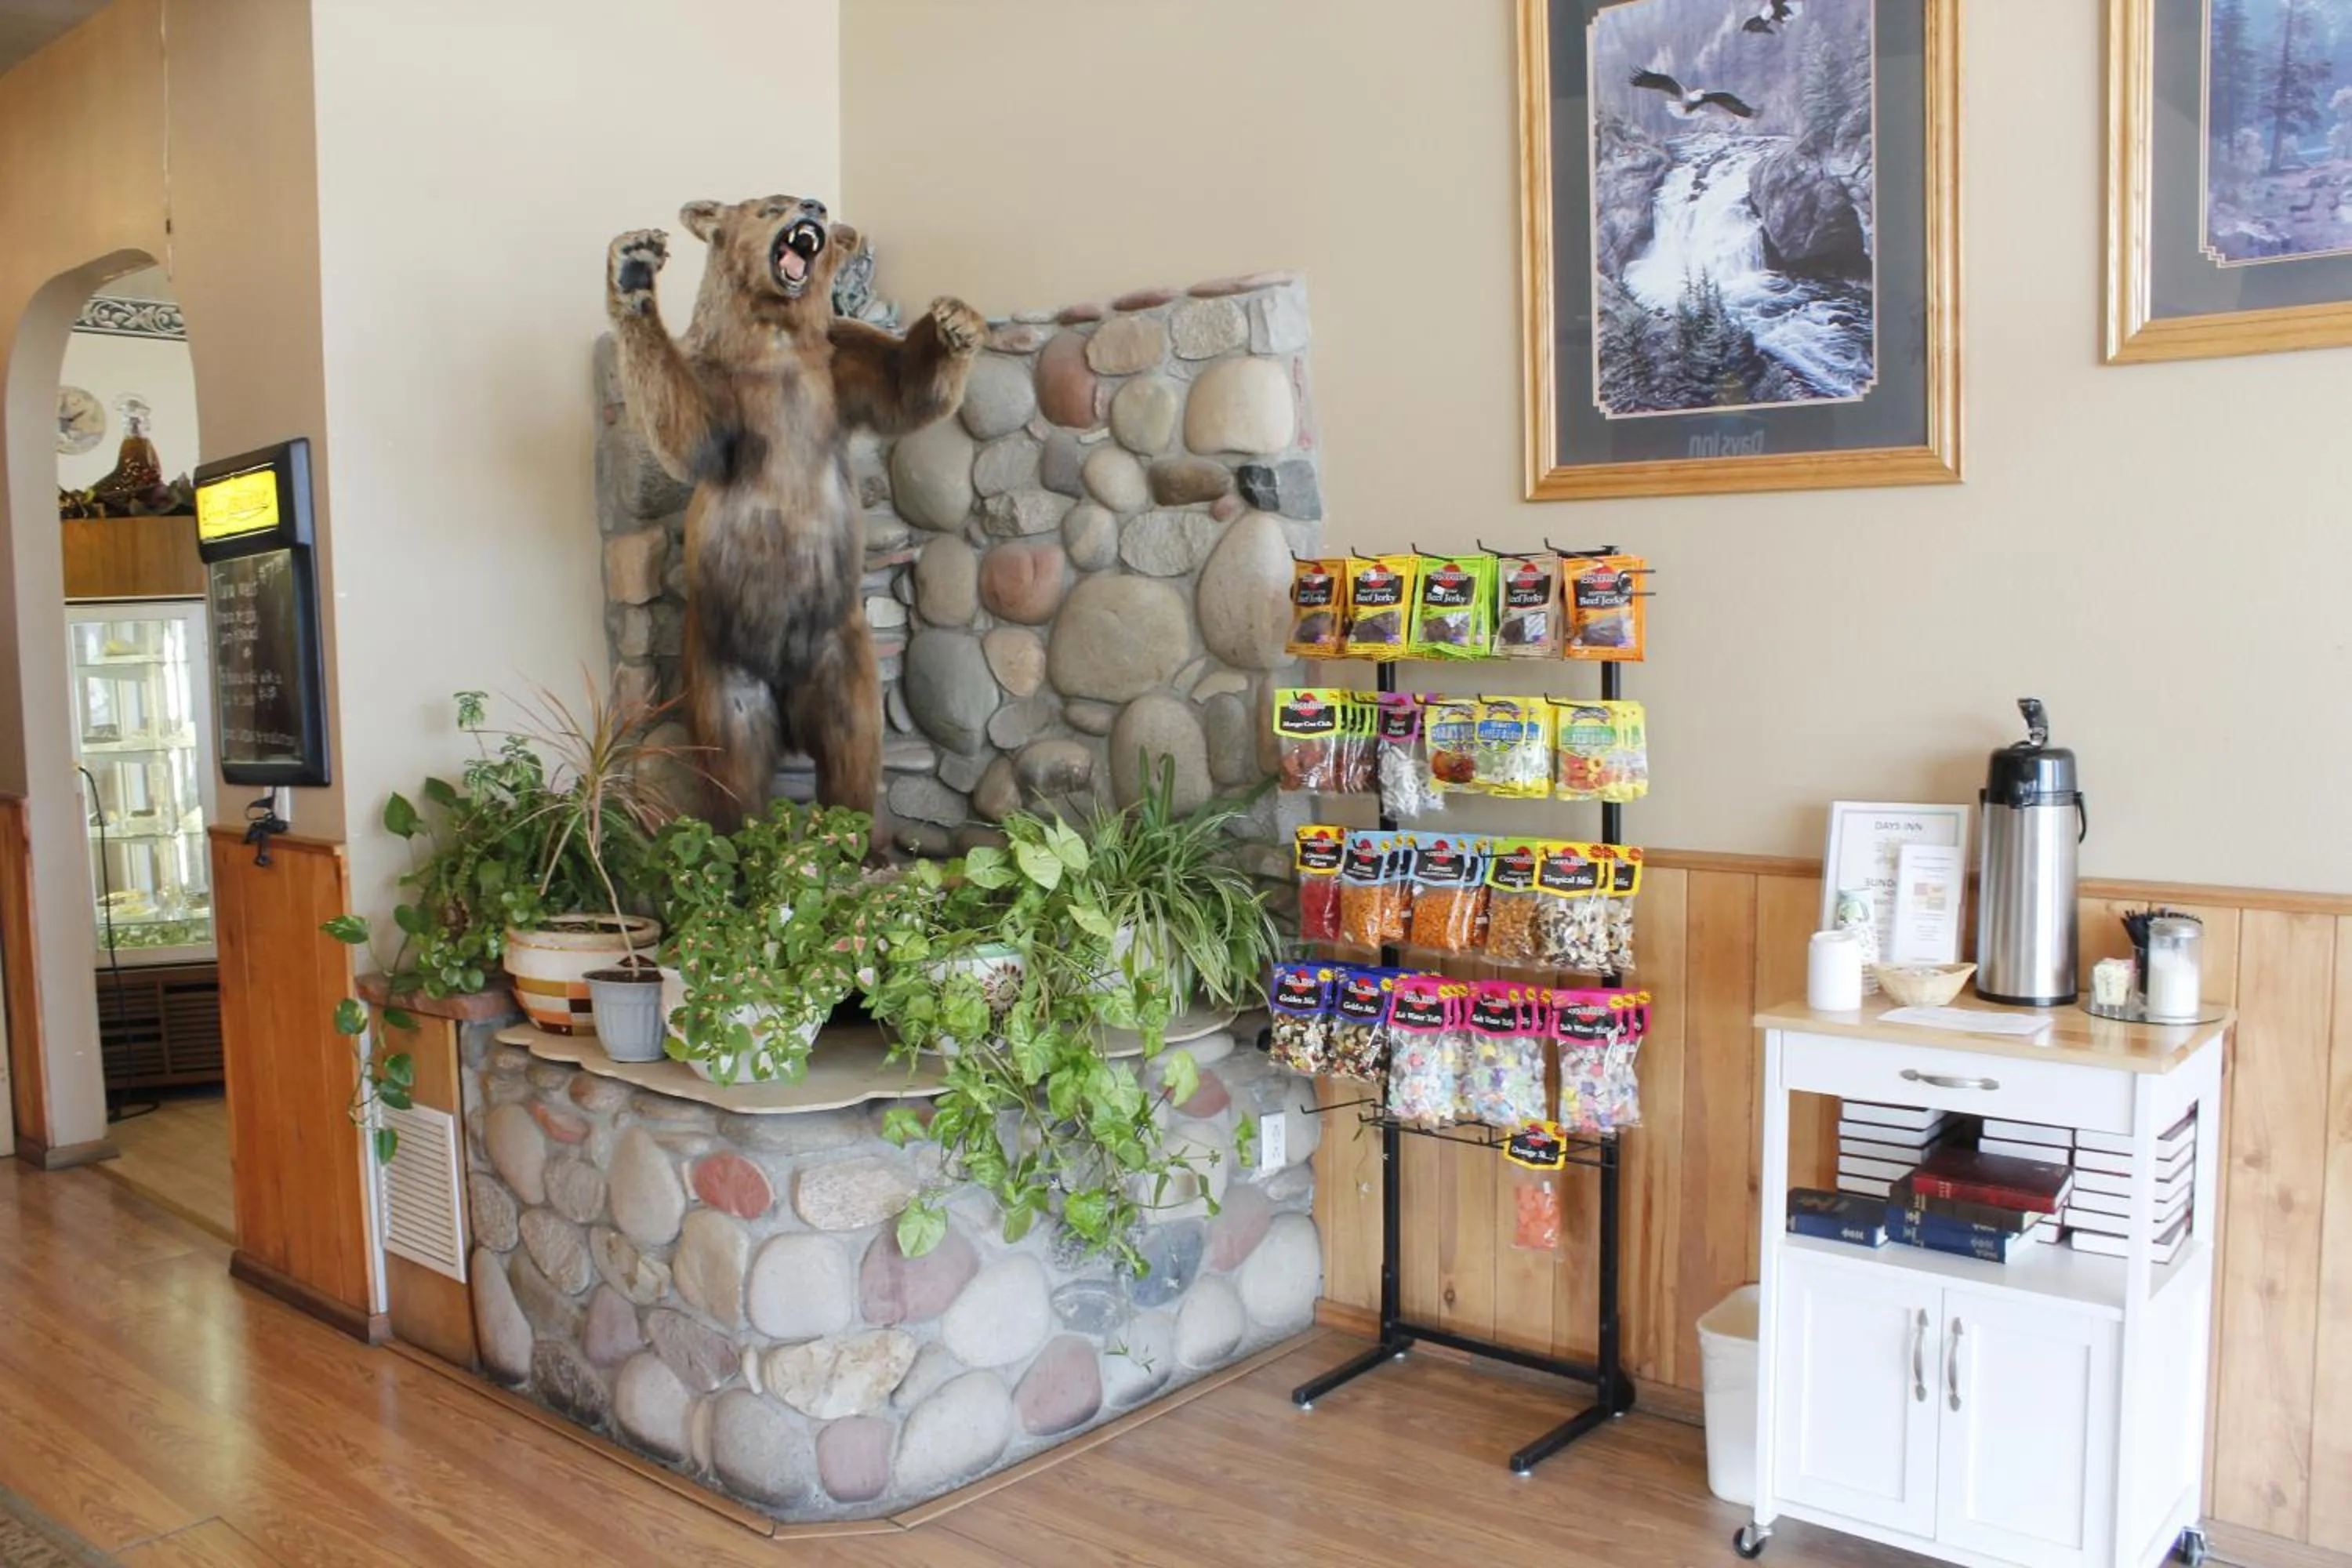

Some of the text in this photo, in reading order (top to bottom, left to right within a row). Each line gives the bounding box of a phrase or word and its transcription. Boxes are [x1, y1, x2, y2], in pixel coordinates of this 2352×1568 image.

[1356, 593, 1396, 604] Beef Jerky
[1444, 593, 1468, 604] Jerky
[1579, 596, 1630, 606] Beef Jerky
[1875, 821, 1922, 831] DAYS INN
[1576, 876, 1594, 885] Mix
